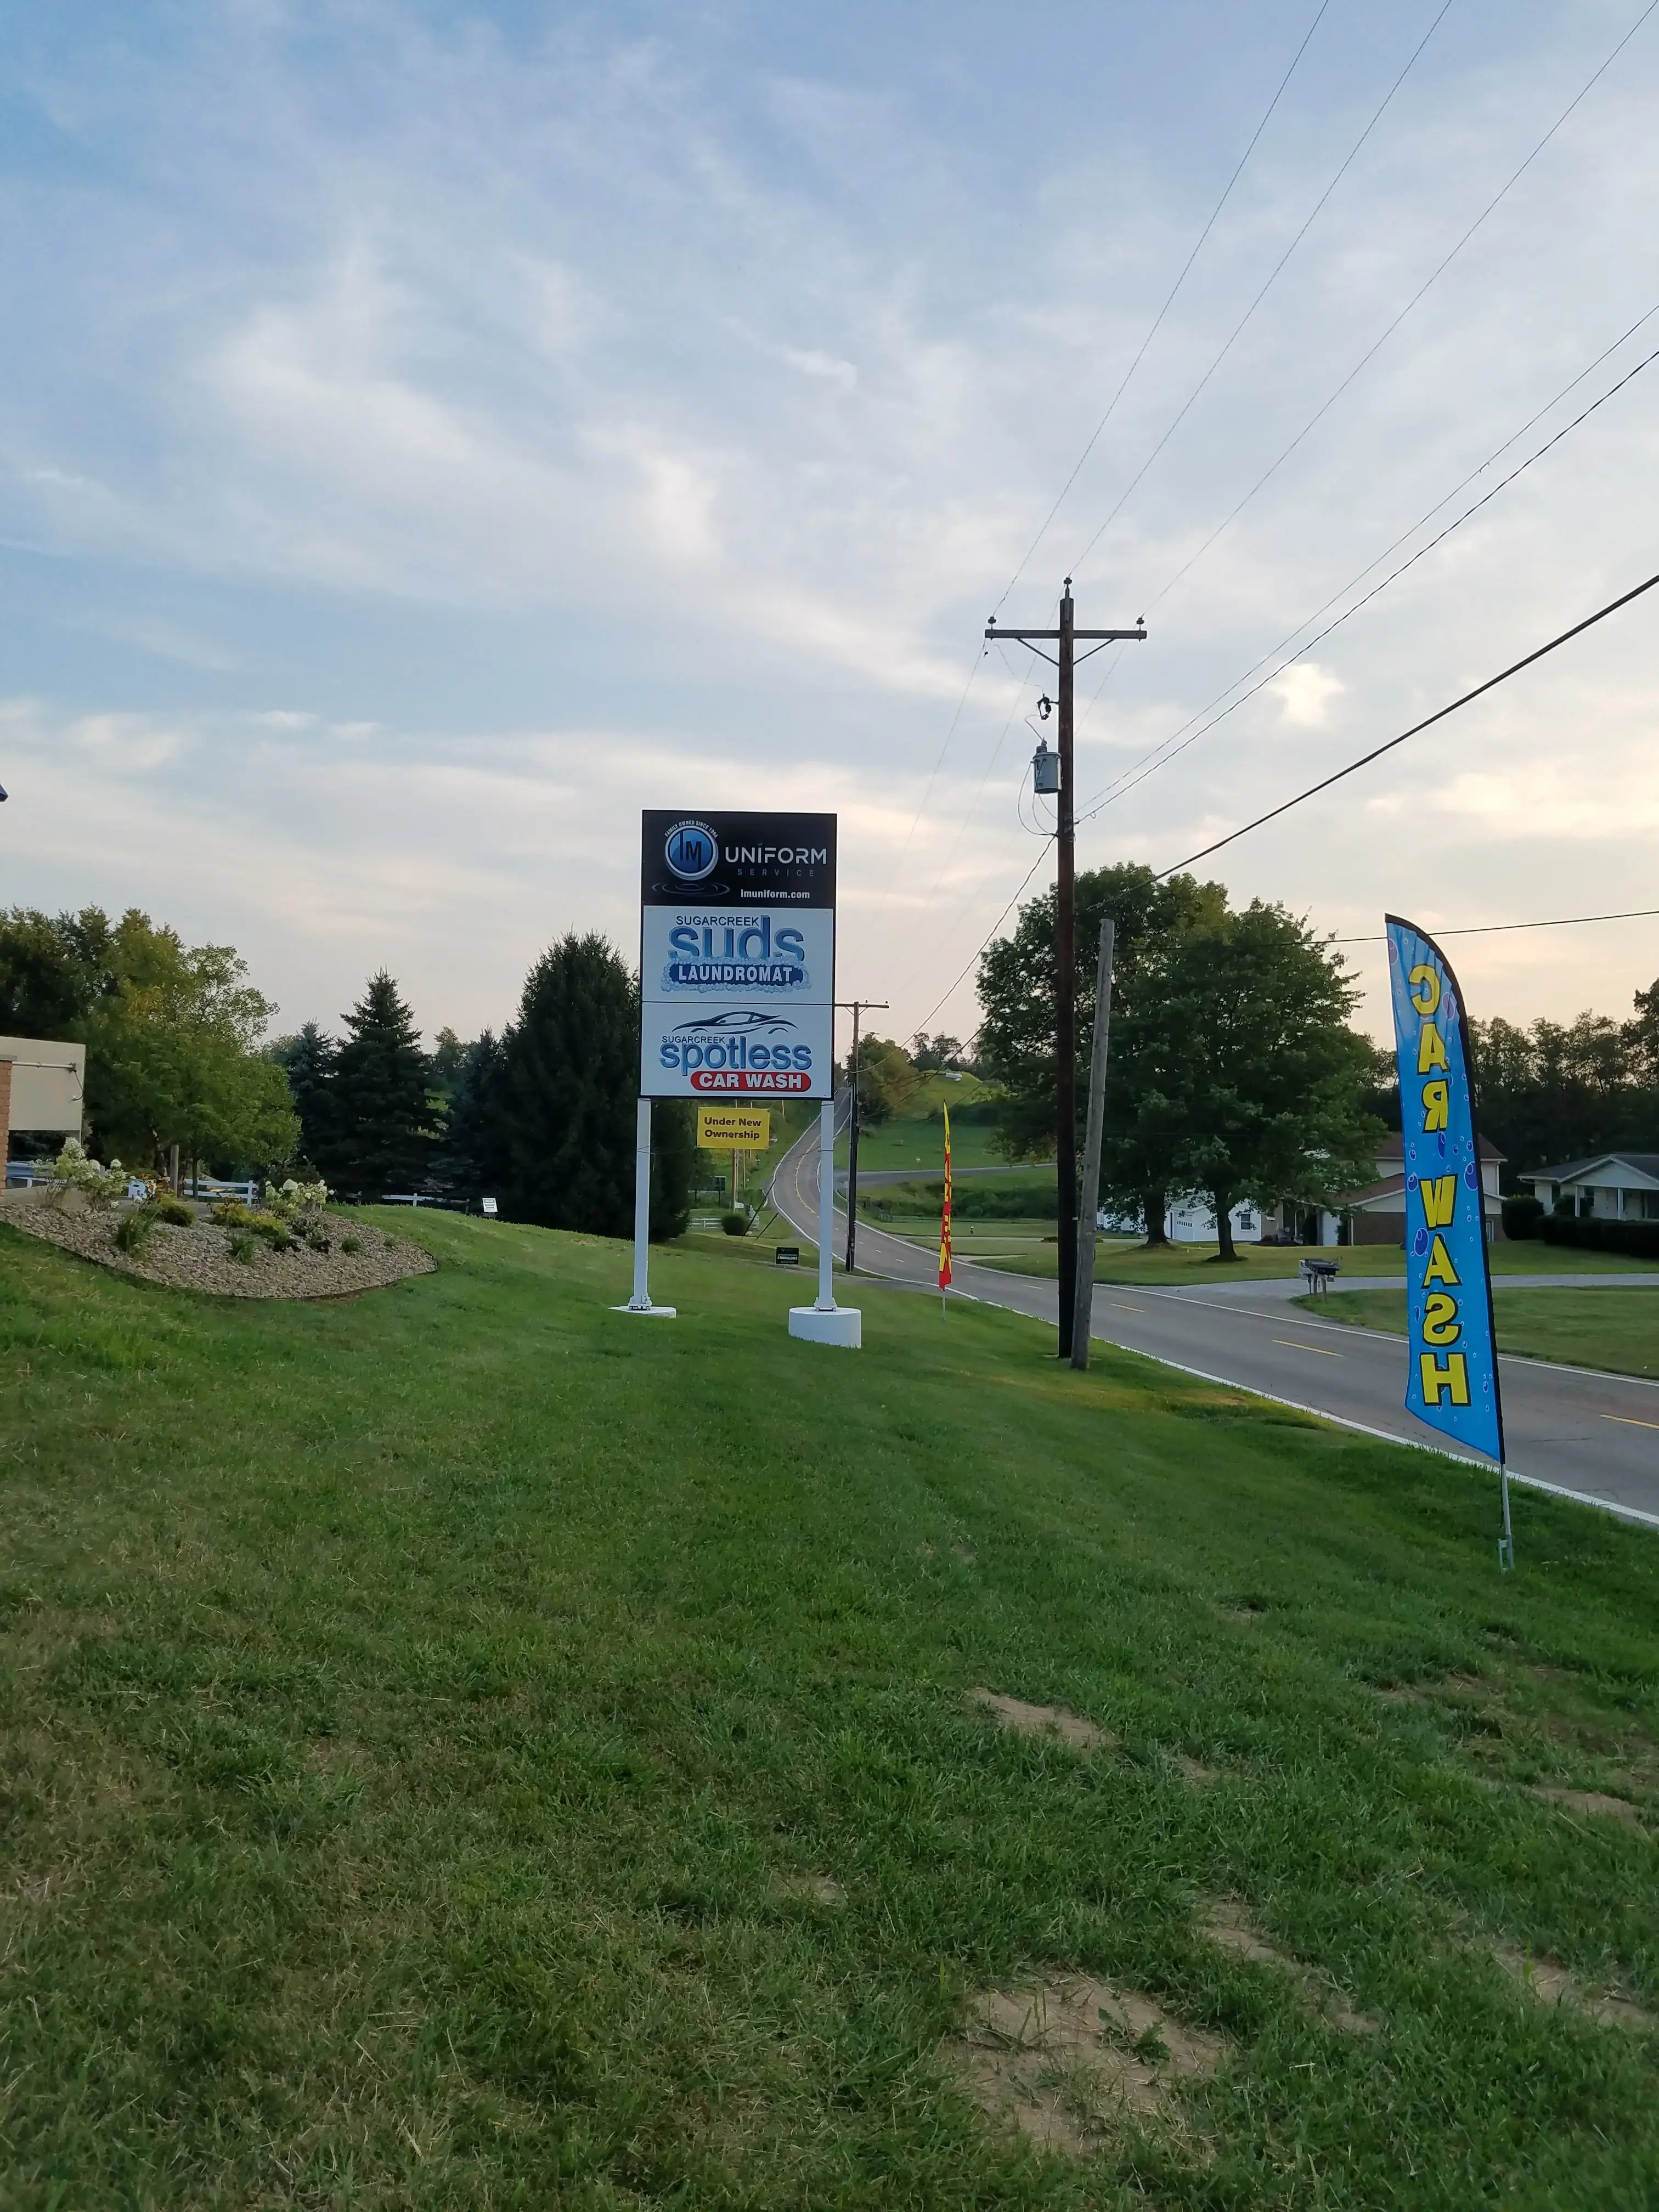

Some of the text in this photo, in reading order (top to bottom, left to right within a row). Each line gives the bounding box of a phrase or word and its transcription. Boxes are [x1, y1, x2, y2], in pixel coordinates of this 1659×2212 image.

[664, 823, 678, 837] FAMILY
[696, 821, 709, 830] SINCE
[725, 843, 827, 865] UNIFORM
[737, 868, 814, 877] SERVICE
[675, 916, 759, 927] SUGARCREEK
[667, 915, 805, 961] suds
[678, 965, 793, 982] LAUNDROMAT
[662, 1035, 726, 1045] SUGARCREEK
[659, 1036, 812, 1076] spotless
[699, 1073, 802, 1089] CAR WASH
[704, 1116, 761, 1127] Under New
[704, 1129, 760, 1141] Ownership
